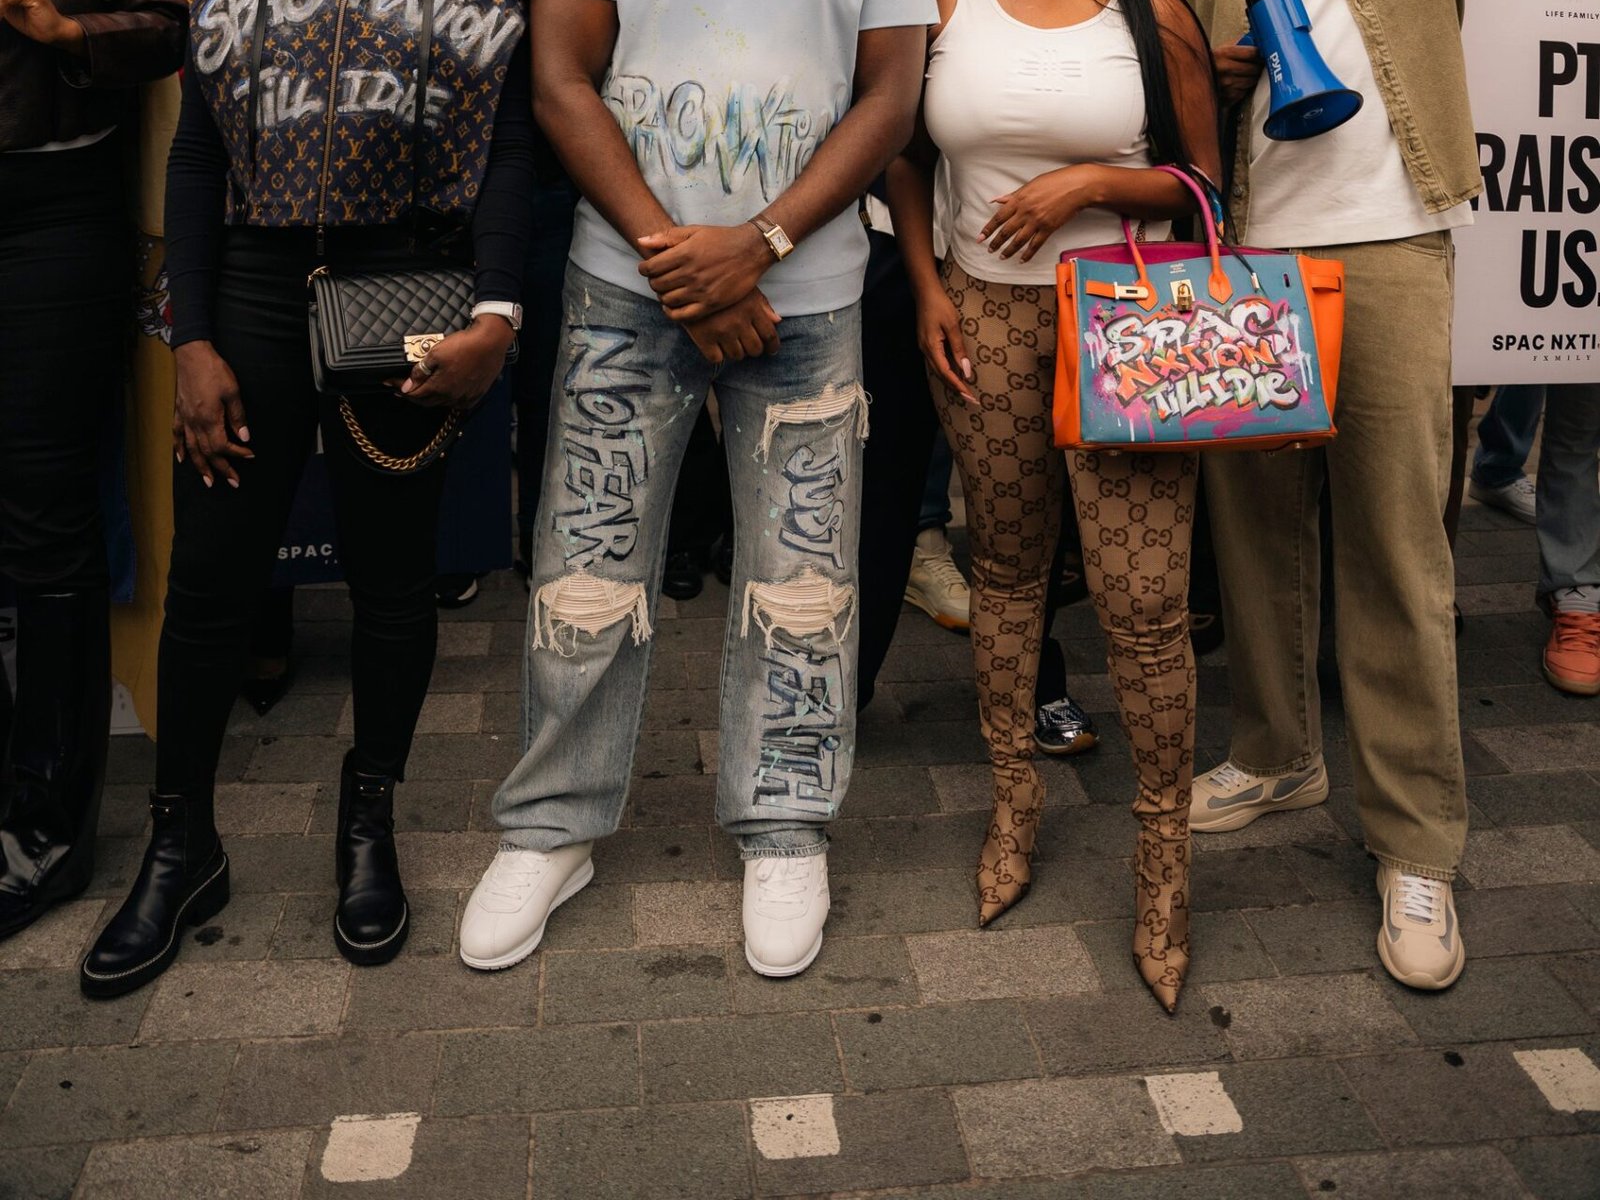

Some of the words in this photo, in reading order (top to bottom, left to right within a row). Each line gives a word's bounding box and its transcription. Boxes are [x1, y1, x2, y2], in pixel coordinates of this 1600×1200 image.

[1545, 10, 1564, 18] LIFE
[1568, 11, 1600, 20] FAMILY
[1492, 334, 1545, 351] SPAC
[564, 323, 652, 427] NO
[555, 424, 649, 569] FEAR
[779, 434, 848, 570] JUST
[278, 543, 333, 559] SPAC
